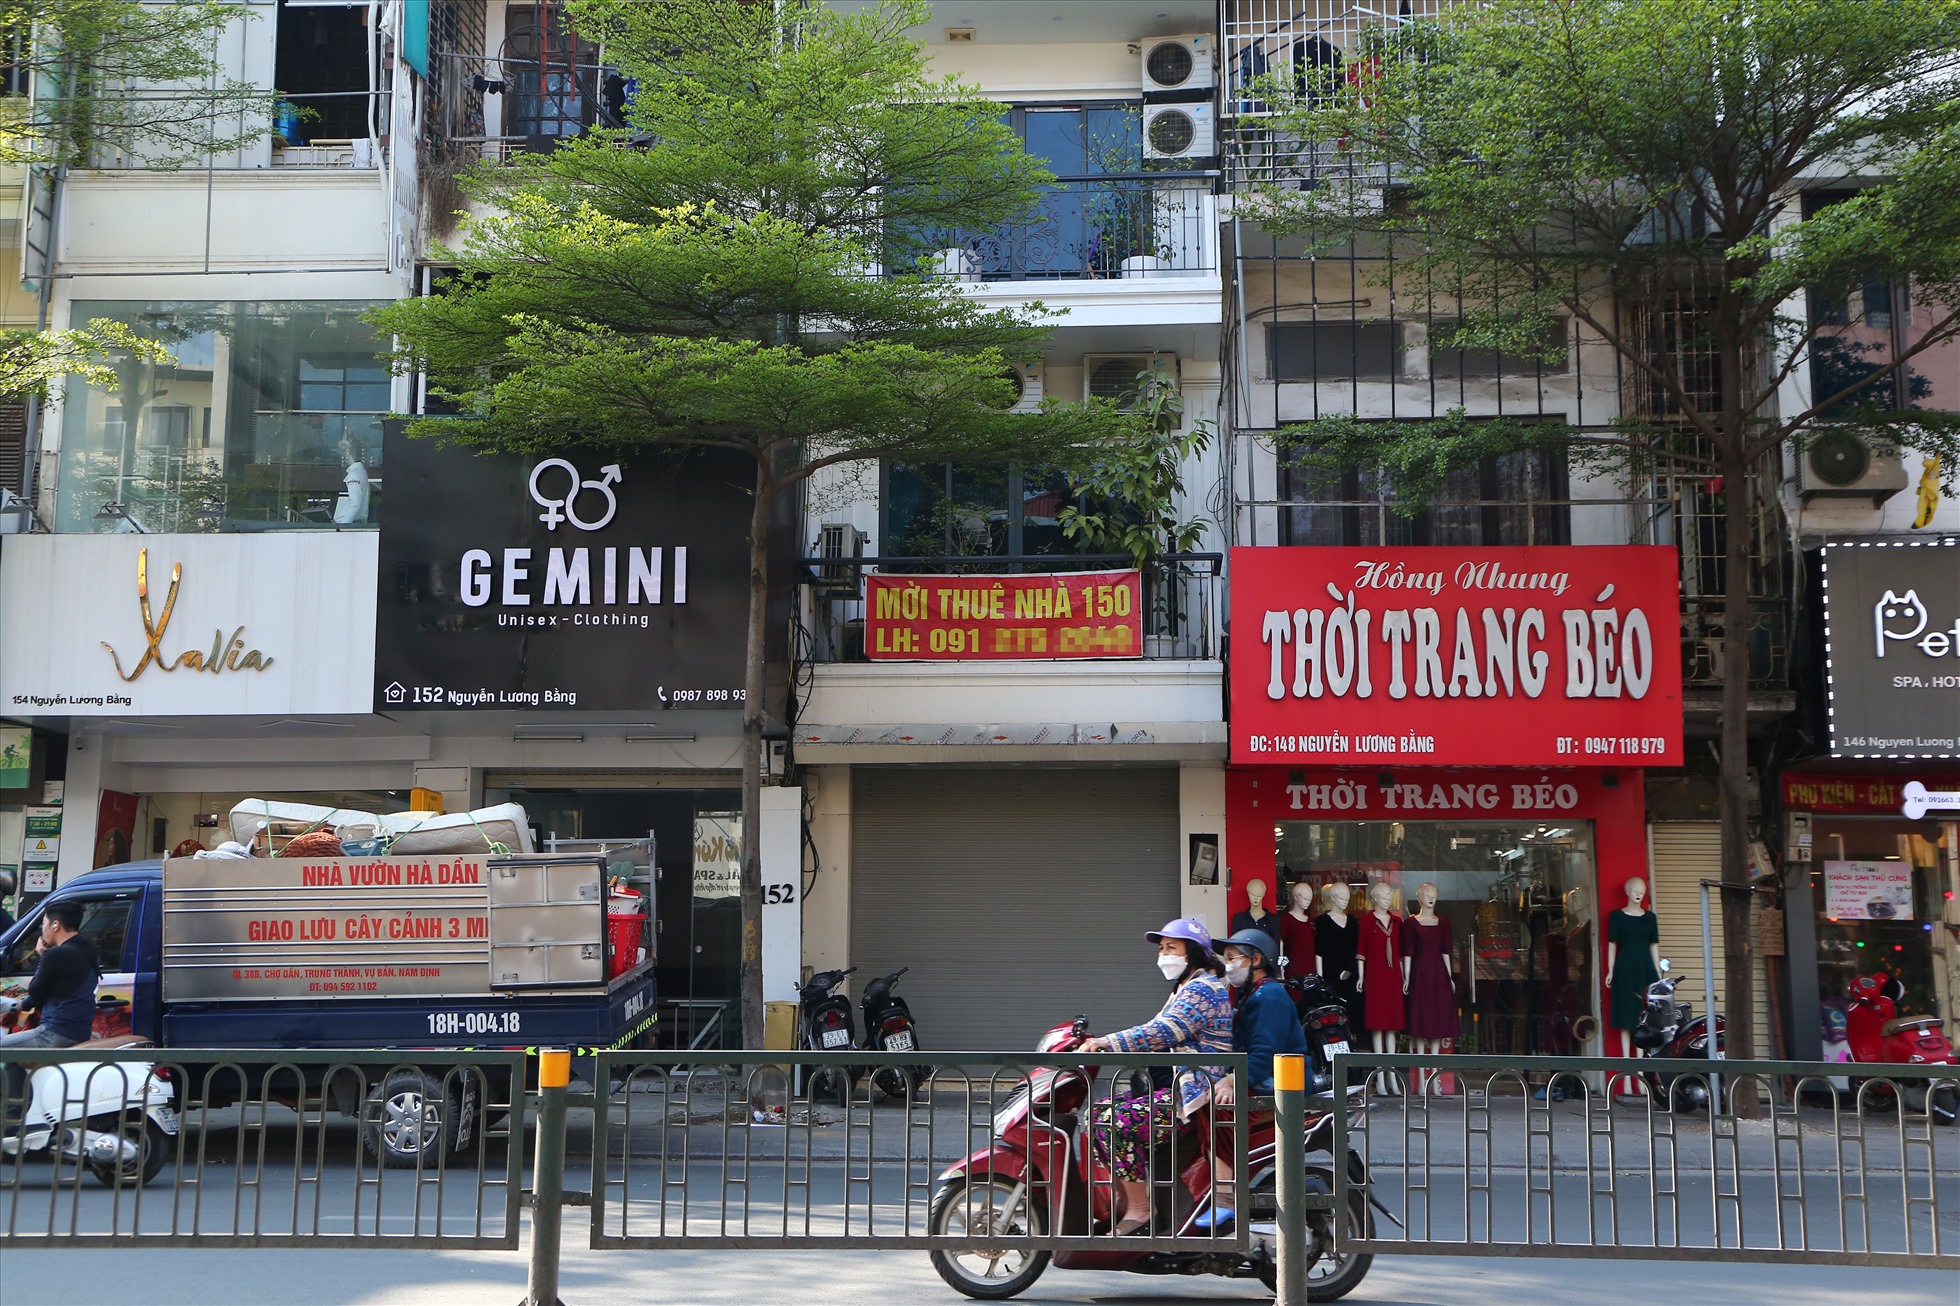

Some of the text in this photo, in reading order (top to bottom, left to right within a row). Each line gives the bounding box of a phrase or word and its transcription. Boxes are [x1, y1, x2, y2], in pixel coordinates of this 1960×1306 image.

[460, 546, 687, 607] GEMINI
[1354, 560, 1572, 596] Hồng Nhung
[876, 580, 1131, 620] MỜI THUÊ NHÀ 150
[498, 613, 557, 626] Unisex
[574, 613, 649, 628] Clothing
[876, 627, 920, 653] LH:
[929, 627, 979, 653] 091
[1262, 582, 1653, 700] THỜI TRANG BÉO
[12, 693, 132, 706] 154 Nguyễn Lương Bằng
[412, 686, 577, 706] 152 Nguyễn Lương Bằng
[673, 690, 702, 702] 0987
[706, 689, 728, 701] 898
[1274, 735, 1296, 753] 148
[1298, 730, 1349, 753] NGUYỄN
[1355, 735, 1396, 753] LƯƠNG
[1400, 729, 1435, 753] BẰNG
[1585, 736, 1617, 754] 0947
[1619, 737, 1639, 754] 118
[1641, 737, 1665, 754] 979
[1843, 737, 1866, 747] 146
[1869, 737, 1914, 749] Nguyen
[1917, 736, 1954, 749] Luong
[1286, 776, 1579, 810] THỜI TRANG BÉO
[1789, 784, 1818, 808] PHỤ
[1913, 796, 1927, 804] Tel:
[303, 857, 479, 886] NHÀ VƯỜN HÀ DẦN
[762, 884, 794, 905] 152
[248, 919, 293, 941] GIAO
[301, 917, 336, 940] LƯU
[345, 914, 383, 939] CÂY
[389, 911, 442, 939] CẢNH
[448, 917, 460, 938] 3
[264, 969, 280, 980] CHỢ
[305, 969, 332, 979] TRUNG
[399, 968, 418, 978] NAM
[420, 968, 440, 979] ĐỊNH
[323, 982, 339, 991] 094
[340, 982, 356, 991] 592
[357, 981, 377, 991] 1102
[427, 1012, 521, 1035] 18H-004.18
